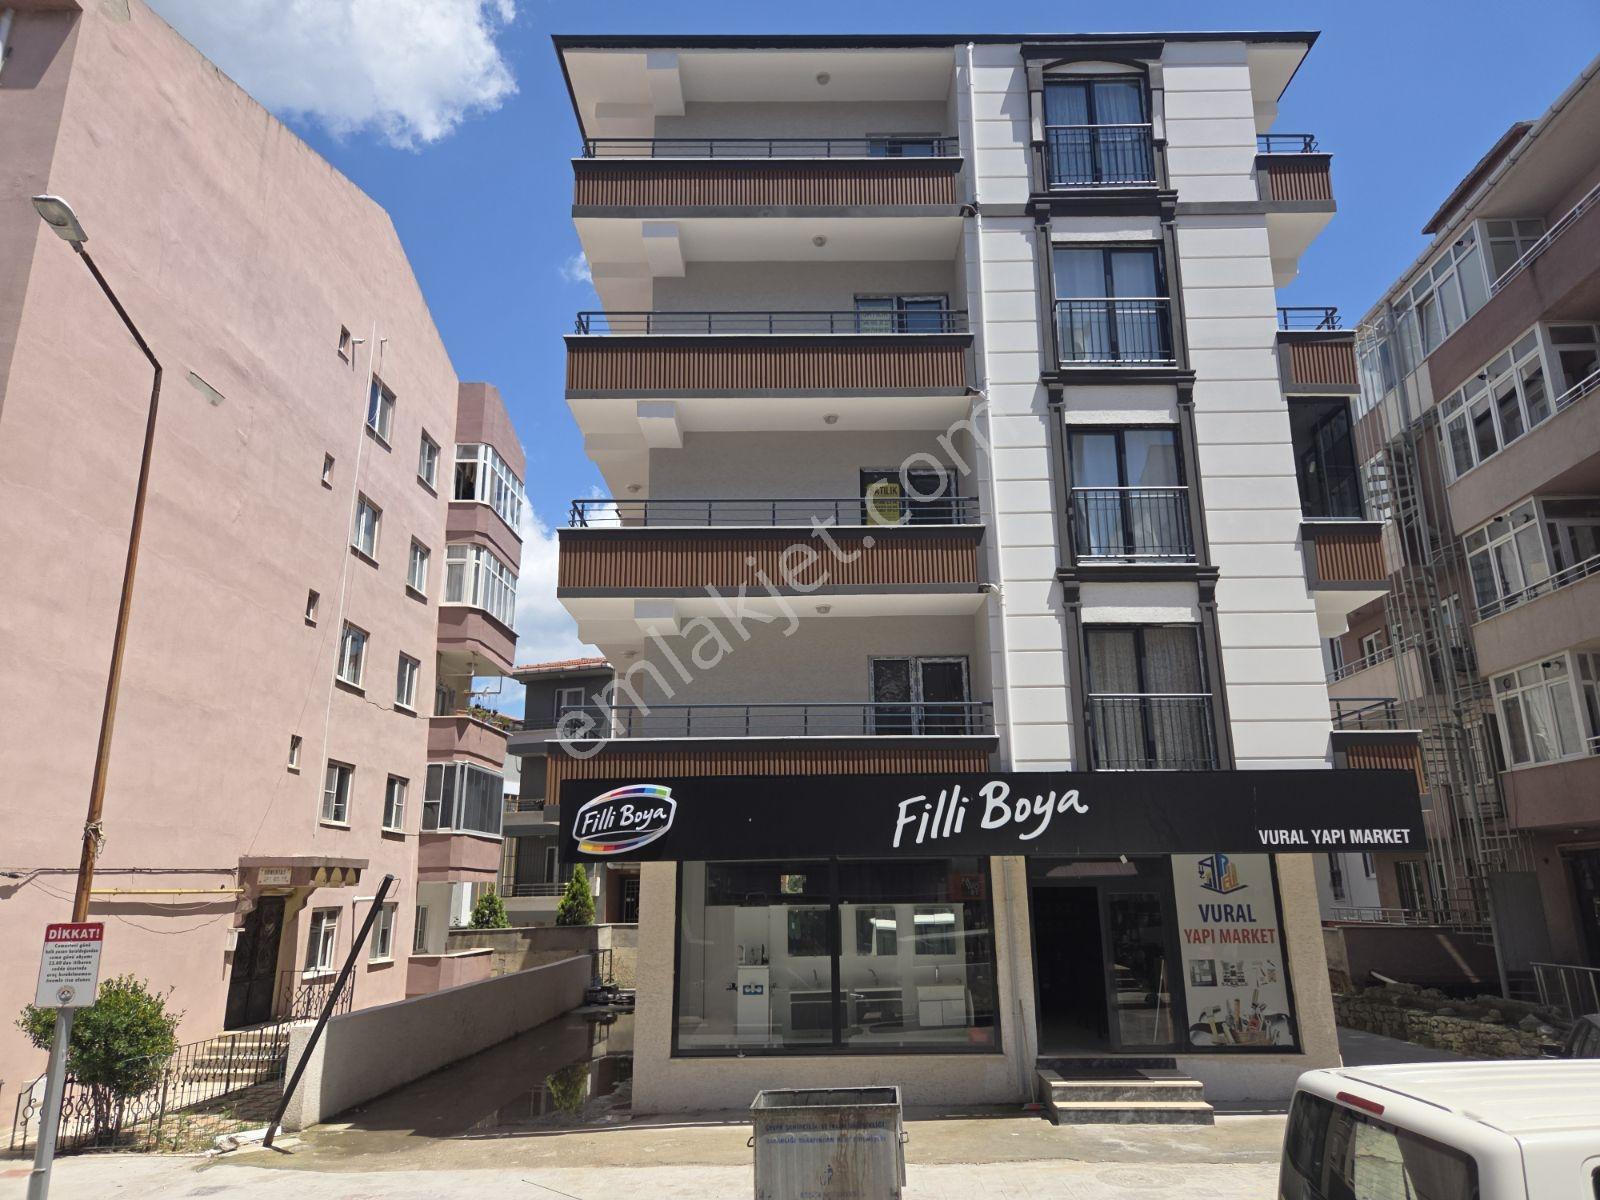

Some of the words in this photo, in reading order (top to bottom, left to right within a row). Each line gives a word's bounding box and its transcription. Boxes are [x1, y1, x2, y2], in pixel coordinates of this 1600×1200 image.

[582, 806, 616, 835] Filli
[620, 804, 667, 831] Boya
[893, 784, 970, 848] Filli
[979, 780, 1089, 840] Boya
[1258, 830, 1309, 845] VURAL
[1311, 829, 1347, 845] YAPI
[1349, 828, 1410, 844] MARKET
[1198, 904, 1257, 923] VURAL
[48, 927, 100, 940] DİKKAT!
[1184, 928, 1216, 945] YAPI
[1219, 928, 1276, 945] MARKET
